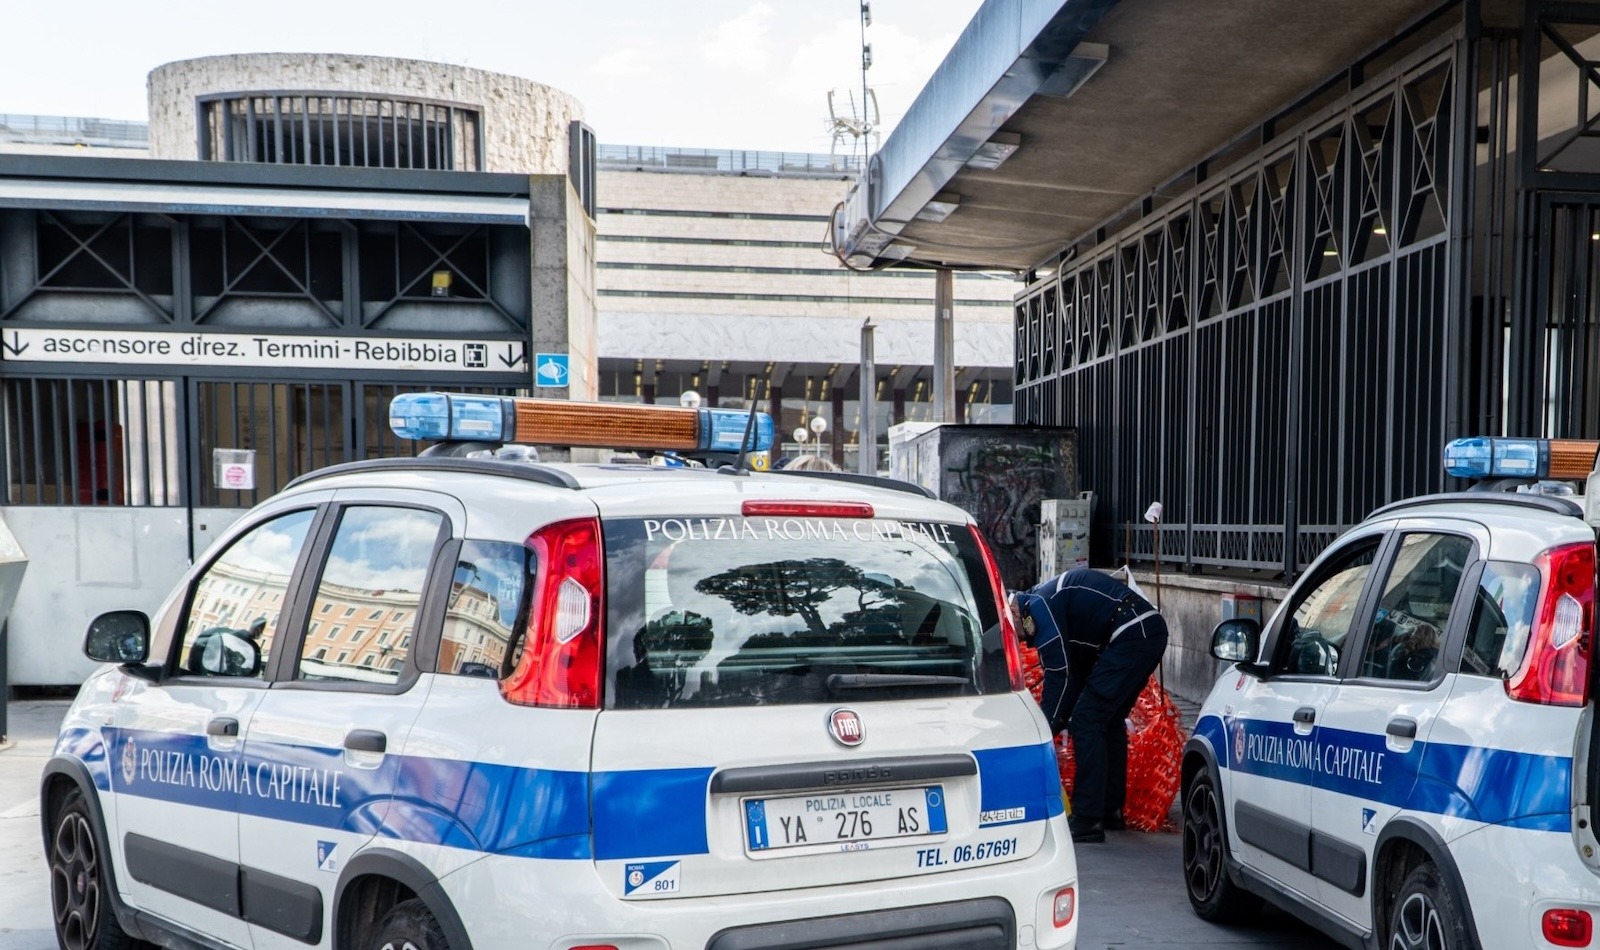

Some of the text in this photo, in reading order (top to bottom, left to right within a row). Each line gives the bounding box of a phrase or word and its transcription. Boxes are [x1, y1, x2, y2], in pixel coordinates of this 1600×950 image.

[43, 336, 456, 363] ascensore direz. Termini-Rebibbia
[643, 518, 956, 544] POLIZIA ROMA CAPITALE
[837, 718, 860, 737] FIAT
[1247, 733, 1385, 784] POLIZIA ROMA CAPITALE
[140, 748, 343, 808] POLIZIA ROMA CAPITALE
[806, 793, 893, 812] POLIZIA LOCALE
[780, 806, 920, 844] YA 276 AS
[916, 837, 1018, 868] TEL. 06.67691
[655, 879, 675, 891] 801
